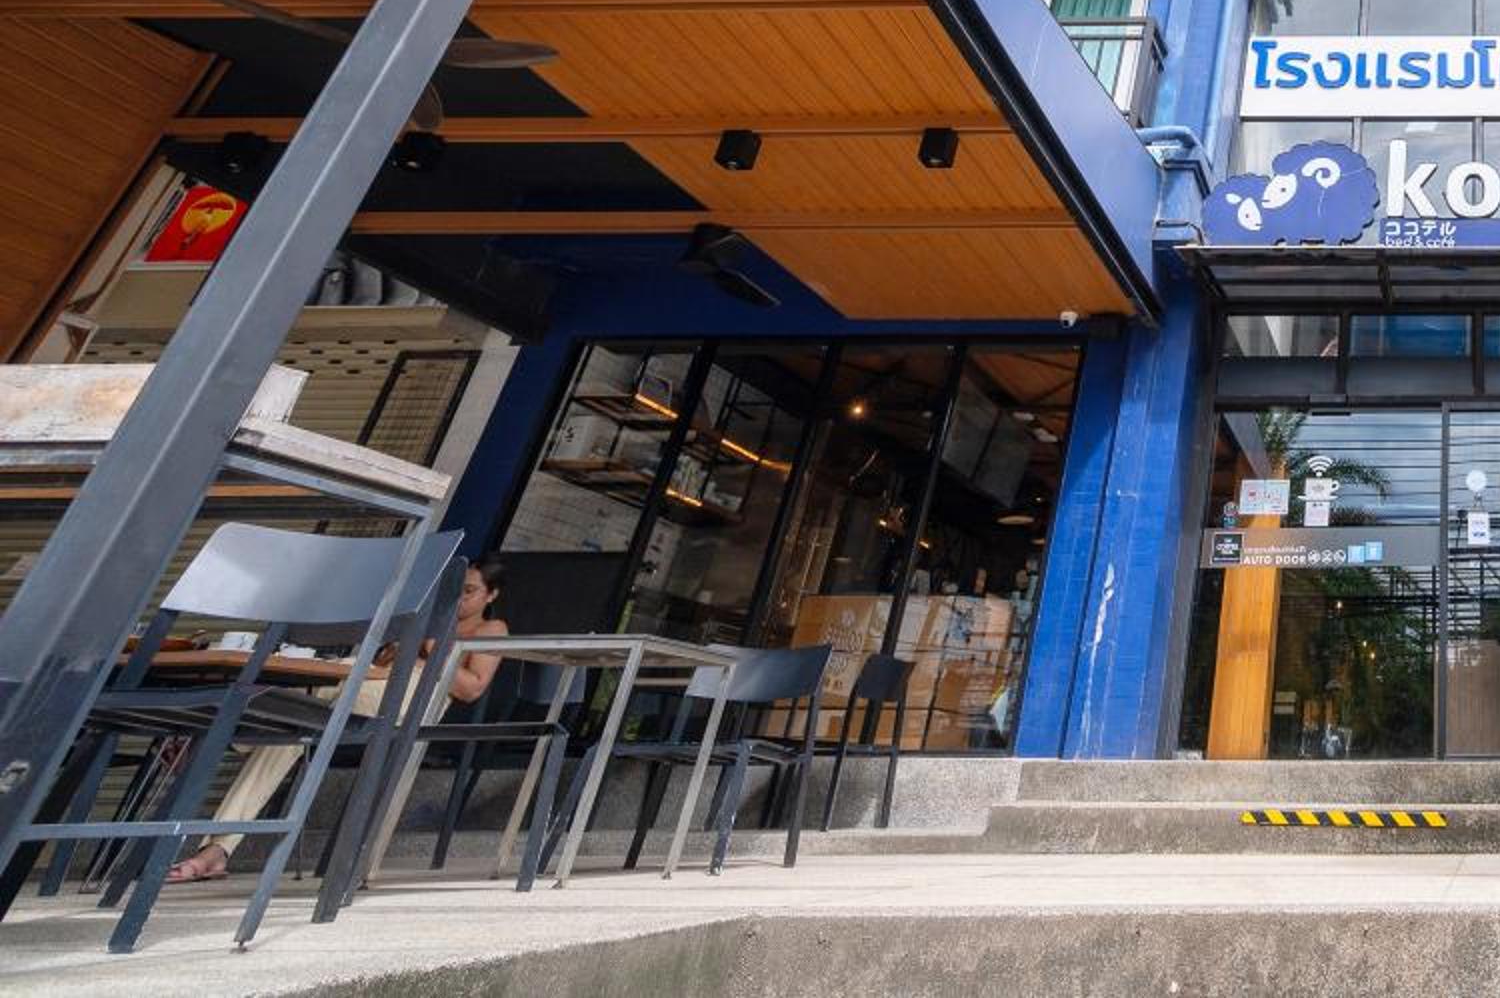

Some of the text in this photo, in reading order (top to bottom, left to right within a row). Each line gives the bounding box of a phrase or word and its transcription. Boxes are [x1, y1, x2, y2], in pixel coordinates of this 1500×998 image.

[1385, 220, 1457, 236] ココテル
[1243, 555, 1307, 565] AUTO DOOR
